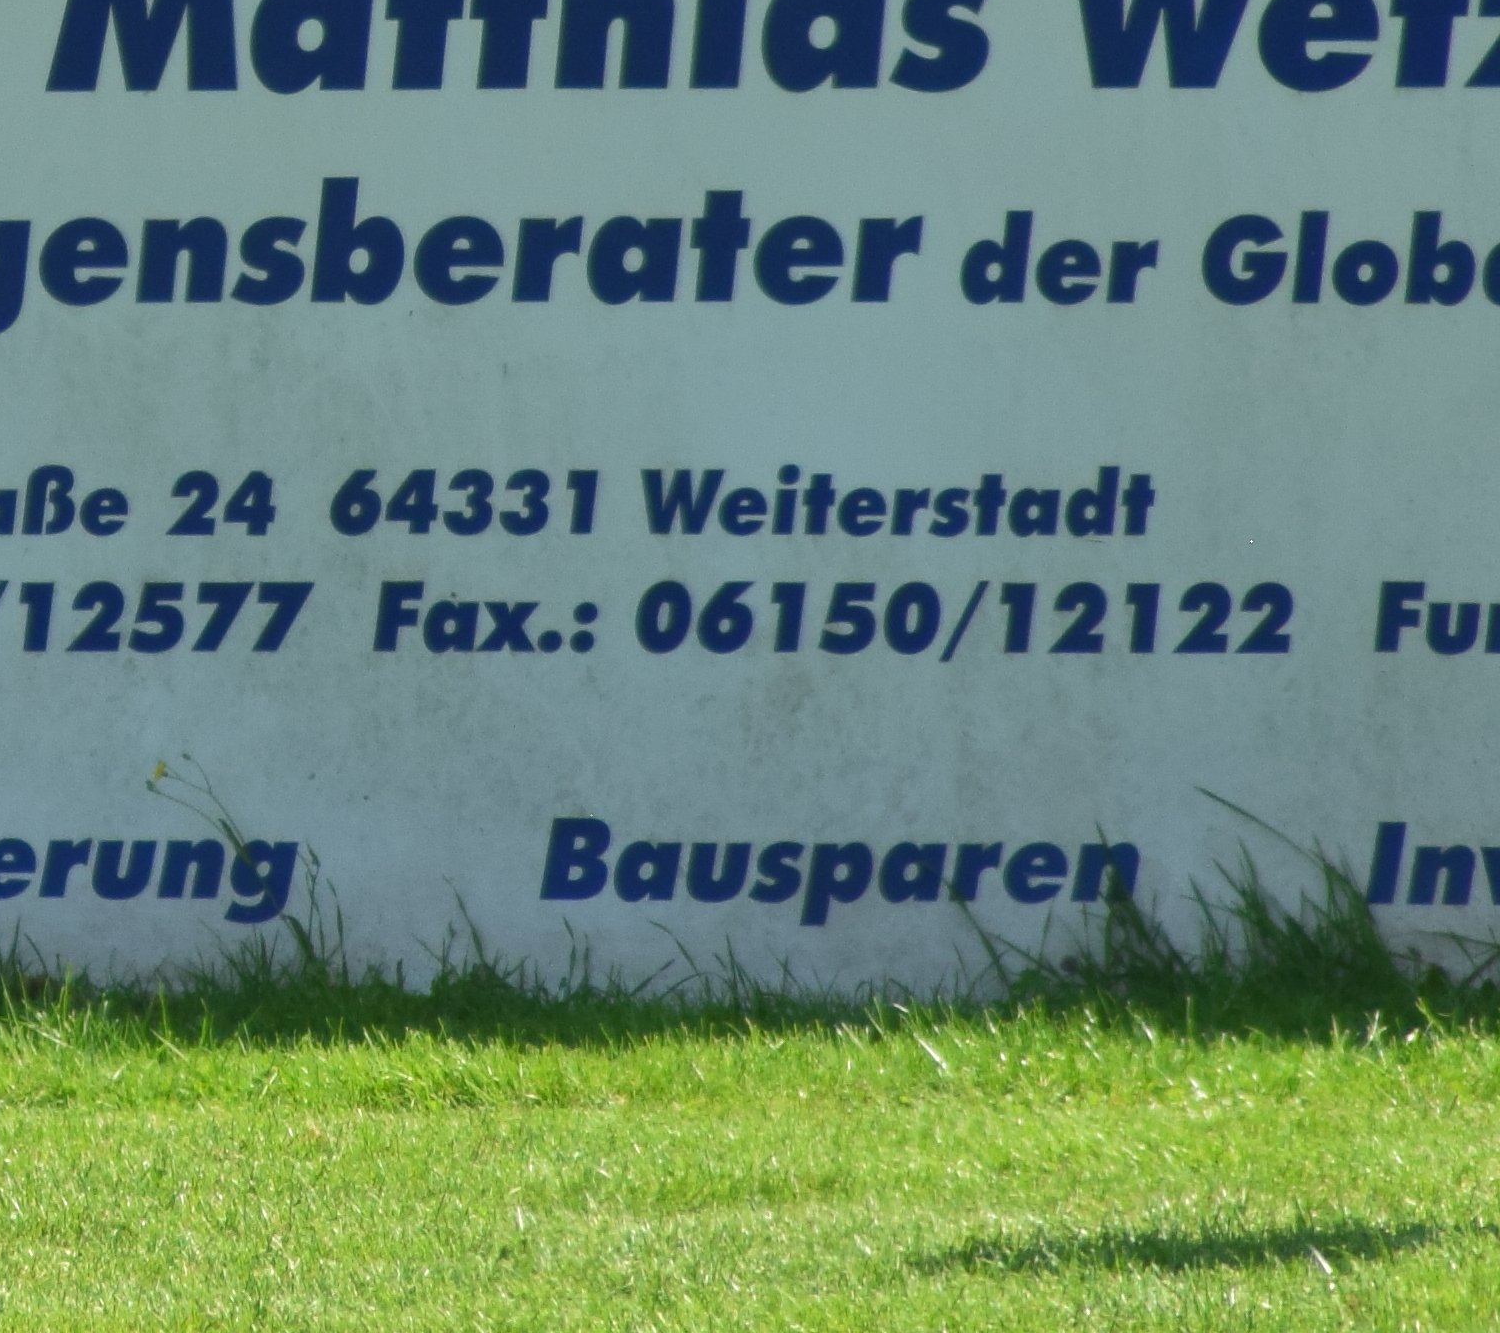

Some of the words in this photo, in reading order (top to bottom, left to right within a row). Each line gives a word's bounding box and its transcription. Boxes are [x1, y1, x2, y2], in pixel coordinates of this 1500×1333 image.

[966, 211, 1159, 305] der
[1207, 212, 1500, 306] Glob
[171, 472, 276, 536] 24
[335, 469, 598, 536] 64331
[648, 464, 1155, 538] Weiterstadt
[376, 581, 599, 653] Fax.:
[642, 581, 1293, 661] 06150/12122
[1380, 582, 1500, 655] Fu
[540, 818, 1142, 928] Bausparen
[1369, 822, 1500, 907] In
